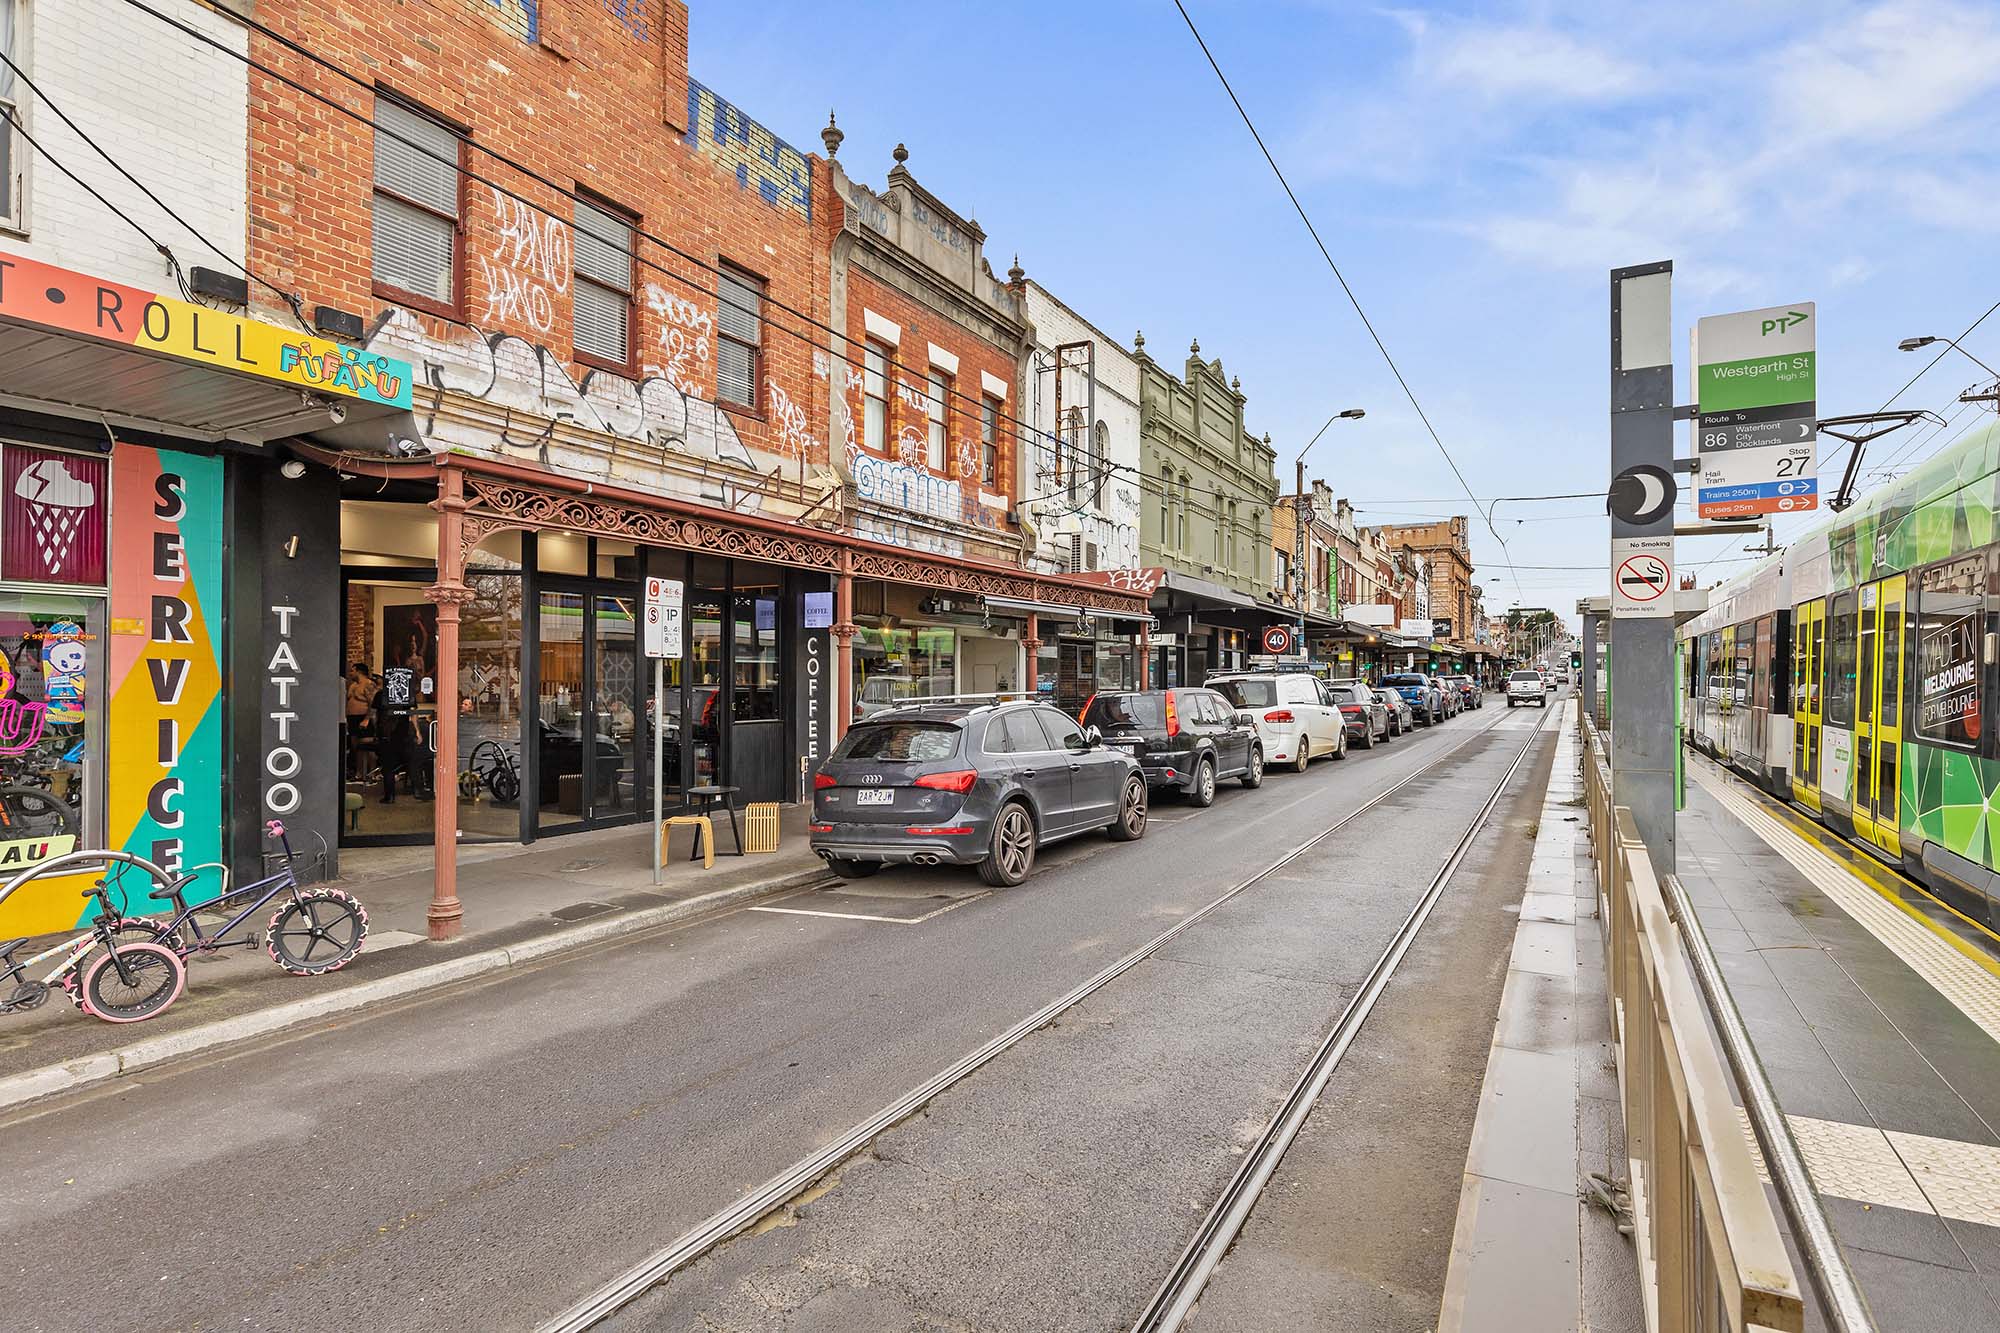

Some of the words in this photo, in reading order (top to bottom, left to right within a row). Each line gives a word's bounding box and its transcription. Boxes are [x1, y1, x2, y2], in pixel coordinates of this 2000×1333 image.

[97, 286, 258, 365] ROLL
[1713, 360, 1788, 379] Westgarth
[1792, 357, 1809, 369] St
[1776, 372, 1797, 382] High
[1705, 416, 1729, 424] Route
[1736, 422, 1781, 433] Waterfront
[1705, 432, 1727, 447] 86
[1736, 433, 1753, 442] City
[1736, 438, 1782, 448] Docklands
[1789, 448, 1810, 456] Stop
[1776, 456, 1811, 478] 27
[1705, 490, 1730, 499] Trains
[1732, 488, 1757, 497] 250m
[1705, 505, 1732, 514] Buses
[1734, 504, 1754, 512] 25m
[666, 609, 678, 621] 1P
[1269, 634, 1285, 646] 40
[1924, 627, 1959, 672] MADE
[1962, 620, 1975, 659] IN
[146, 473, 193, 890] SERVICE
[1925, 660, 1975, 696] MELBOURNE
[806, 636, 820, 758] COFFEE
[266, 606, 302, 814] TATTOO
[1925, 704, 1936, 722] FOR
[1937, 691, 1975, 719] MELBOURNE
